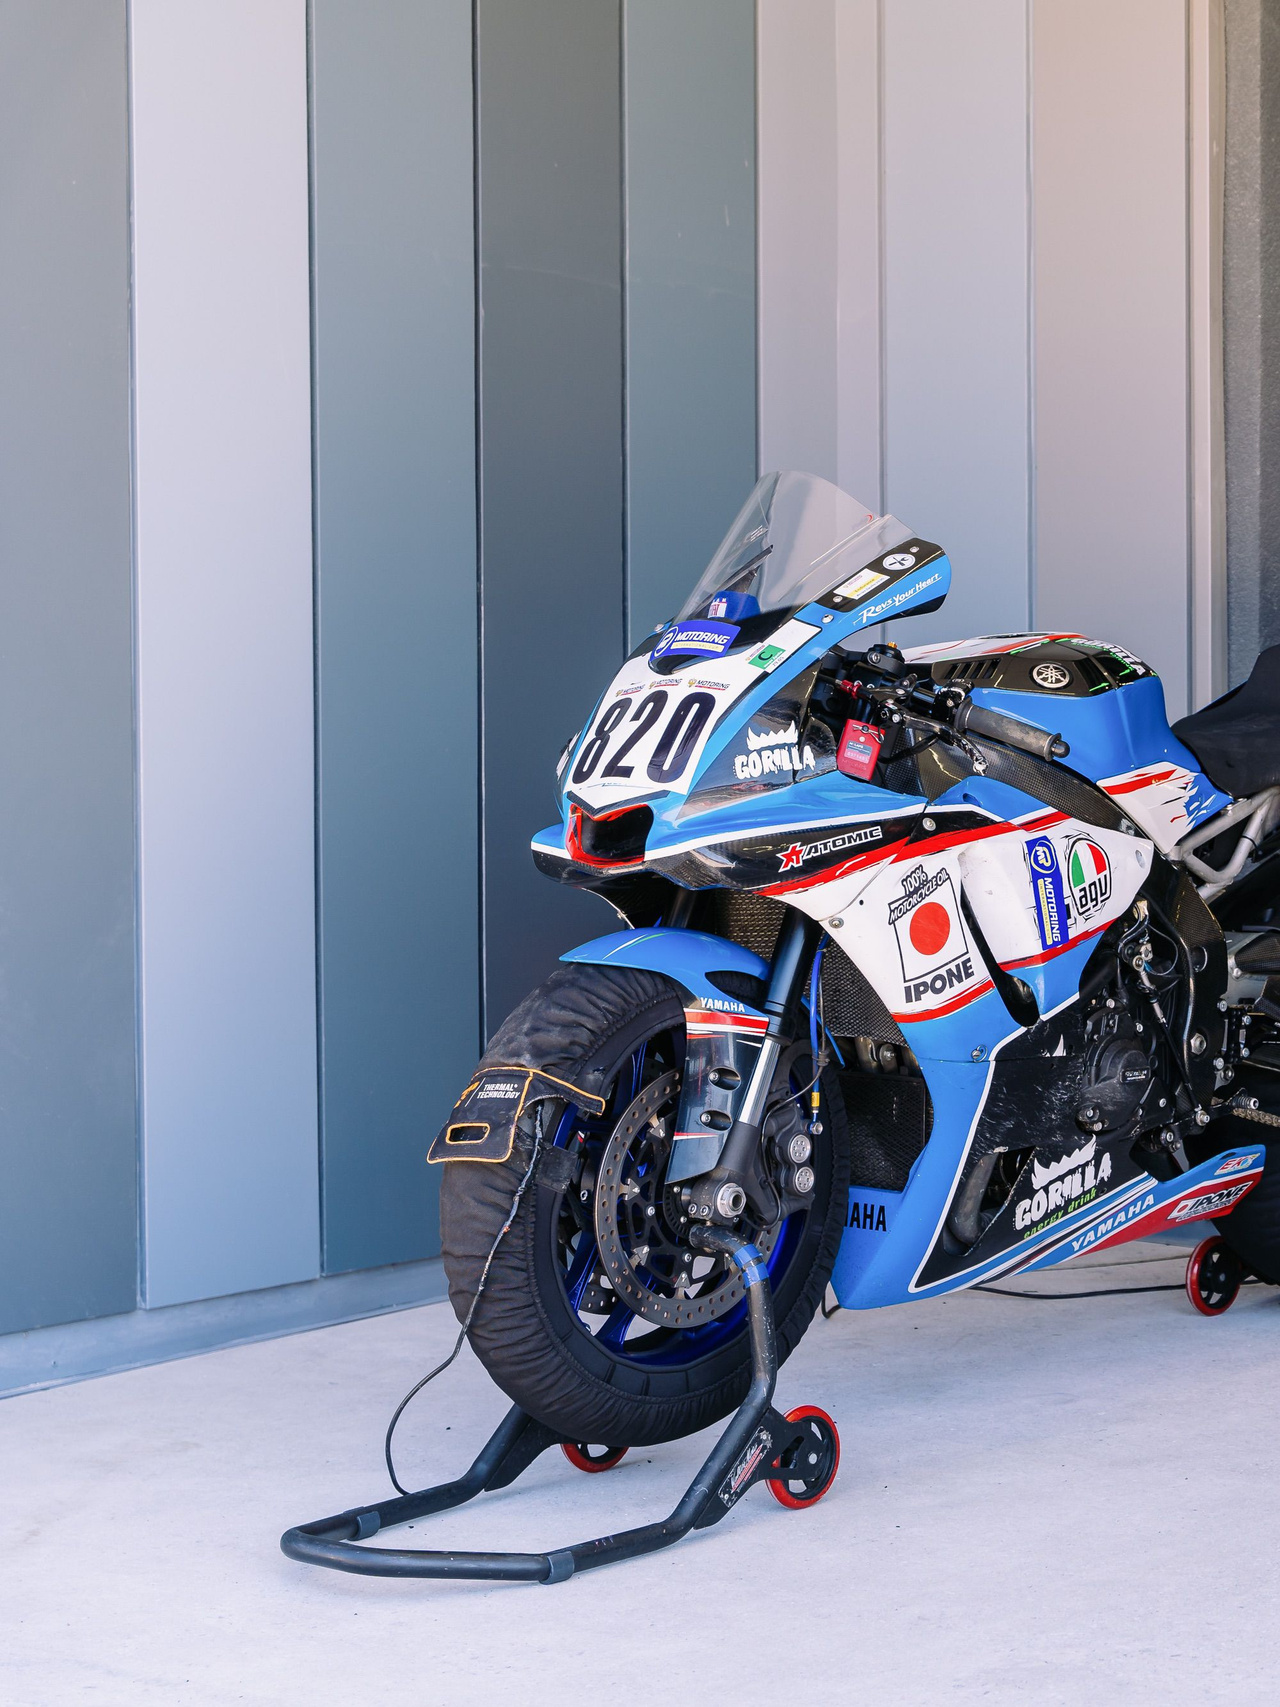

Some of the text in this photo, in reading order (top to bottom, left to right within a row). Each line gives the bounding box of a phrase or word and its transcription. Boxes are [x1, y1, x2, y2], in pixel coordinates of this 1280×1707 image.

[857, 573, 940, 625] Revs Your Heart
[675, 631, 731, 645] MOTORING
[758, 651, 773, 661] C
[697, 680, 730, 689] MOTORING
[572, 689, 717, 785] 820
[733, 744, 816, 780] GORILLA
[804, 827, 882, 858] ATOMIC
[889, 869, 950, 923] MOTORCYCLE OIL
[903, 866, 928, 895] 100%
[1044, 877, 1061, 942] MOTORING
[904, 957, 974, 1003] IPONE
[700, 997, 746, 1012] YAMAHA
[477, 1091, 521, 1099] TECHNOLOGY
[1014, 1152, 1112, 1231] GORILLA
[1189, 1183, 1250, 1211] IPONE
[844, 1201, 887, 1232] AHA
[1023, 1186, 1097, 1240] energy drink
[1071, 1193, 1155, 1252] YAMAHA
